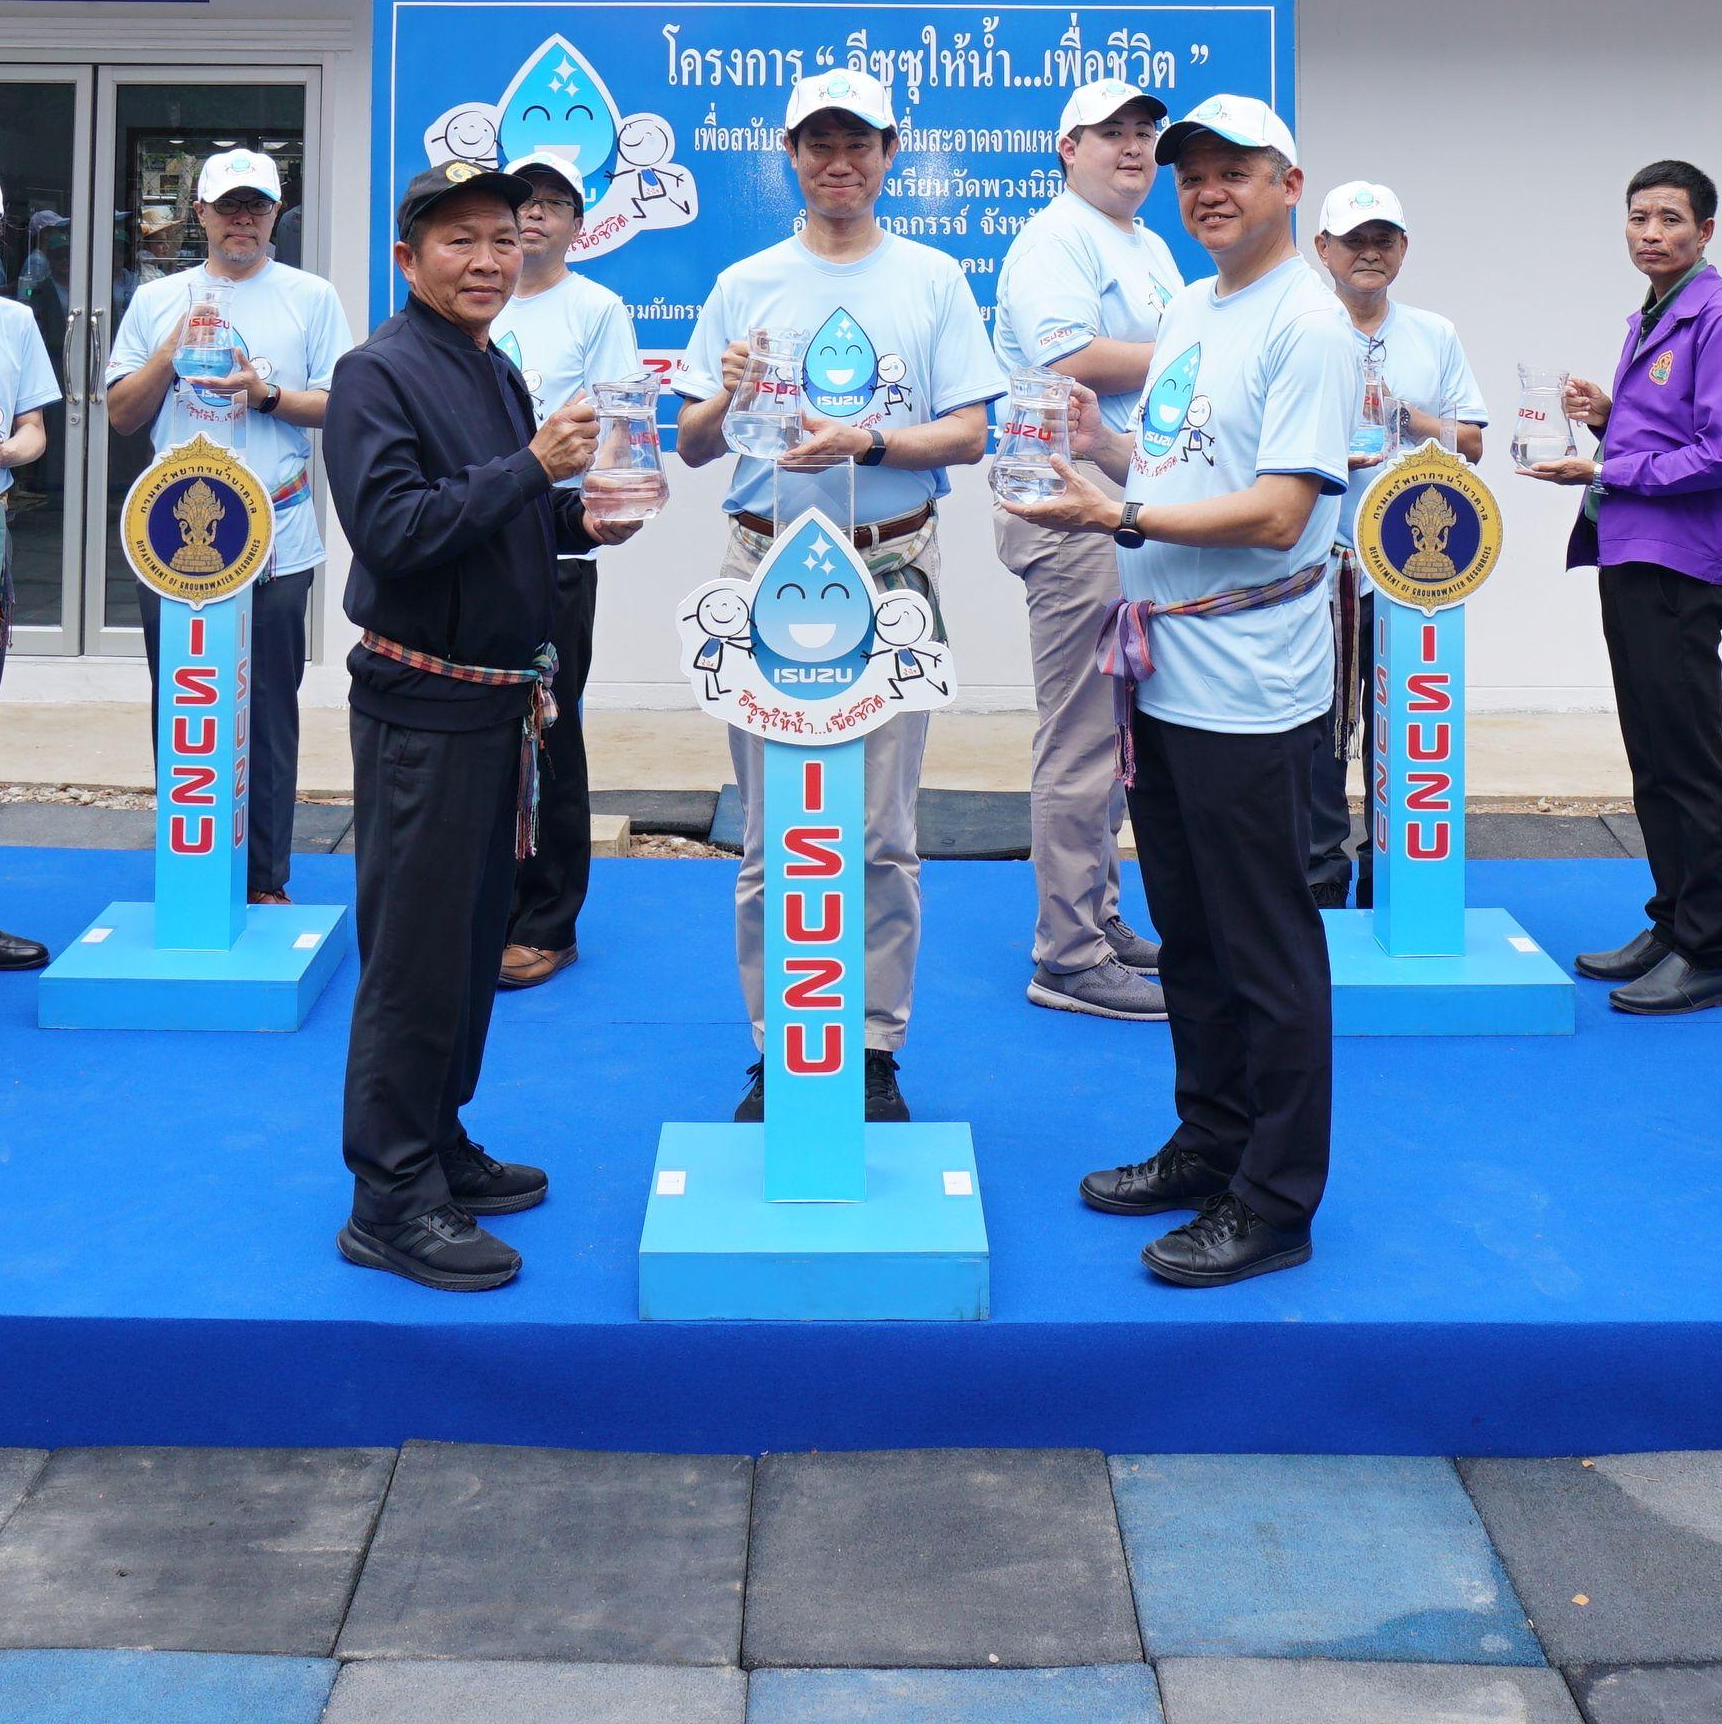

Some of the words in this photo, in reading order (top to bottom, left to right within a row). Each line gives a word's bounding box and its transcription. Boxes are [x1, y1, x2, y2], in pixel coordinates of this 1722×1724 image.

[663, 24, 803, 87] โครงการ
[189, 317, 230, 329] ISUZU
[755, 381, 801, 397] ISUZ
[817, 396, 865, 406] ISUZU
[1003, 422, 1052, 442] SUZU
[140, 465, 258, 515] กรมทรัพยากรน้ำบาดาล
[1373, 472, 1489, 522] กรมทรัพยากรน้ำบาดาล
[136, 539, 167, 582] DEPARTMENT
[168, 577, 177, 587] OF
[180, 573, 234, 592] GROUNDWATER
[234, 538, 261, 580] RESOURCES
[1369, 546, 1400, 587] DEPARTMENT
[1401, 584, 1411, 593] OF
[1412, 581, 1466, 597] GROUNDWATER
[1466, 545, 1492, 584] RESOURCES
[773, 668, 853, 684] ISUZU
[170, 617, 219, 855] ISUZU
[233, 610, 249, 849] ISUZU
[1375, 616, 1388, 854] ISUZU
[1405, 624, 1452, 861] ISUZU
[782, 760, 845, 1075] ISUZU
